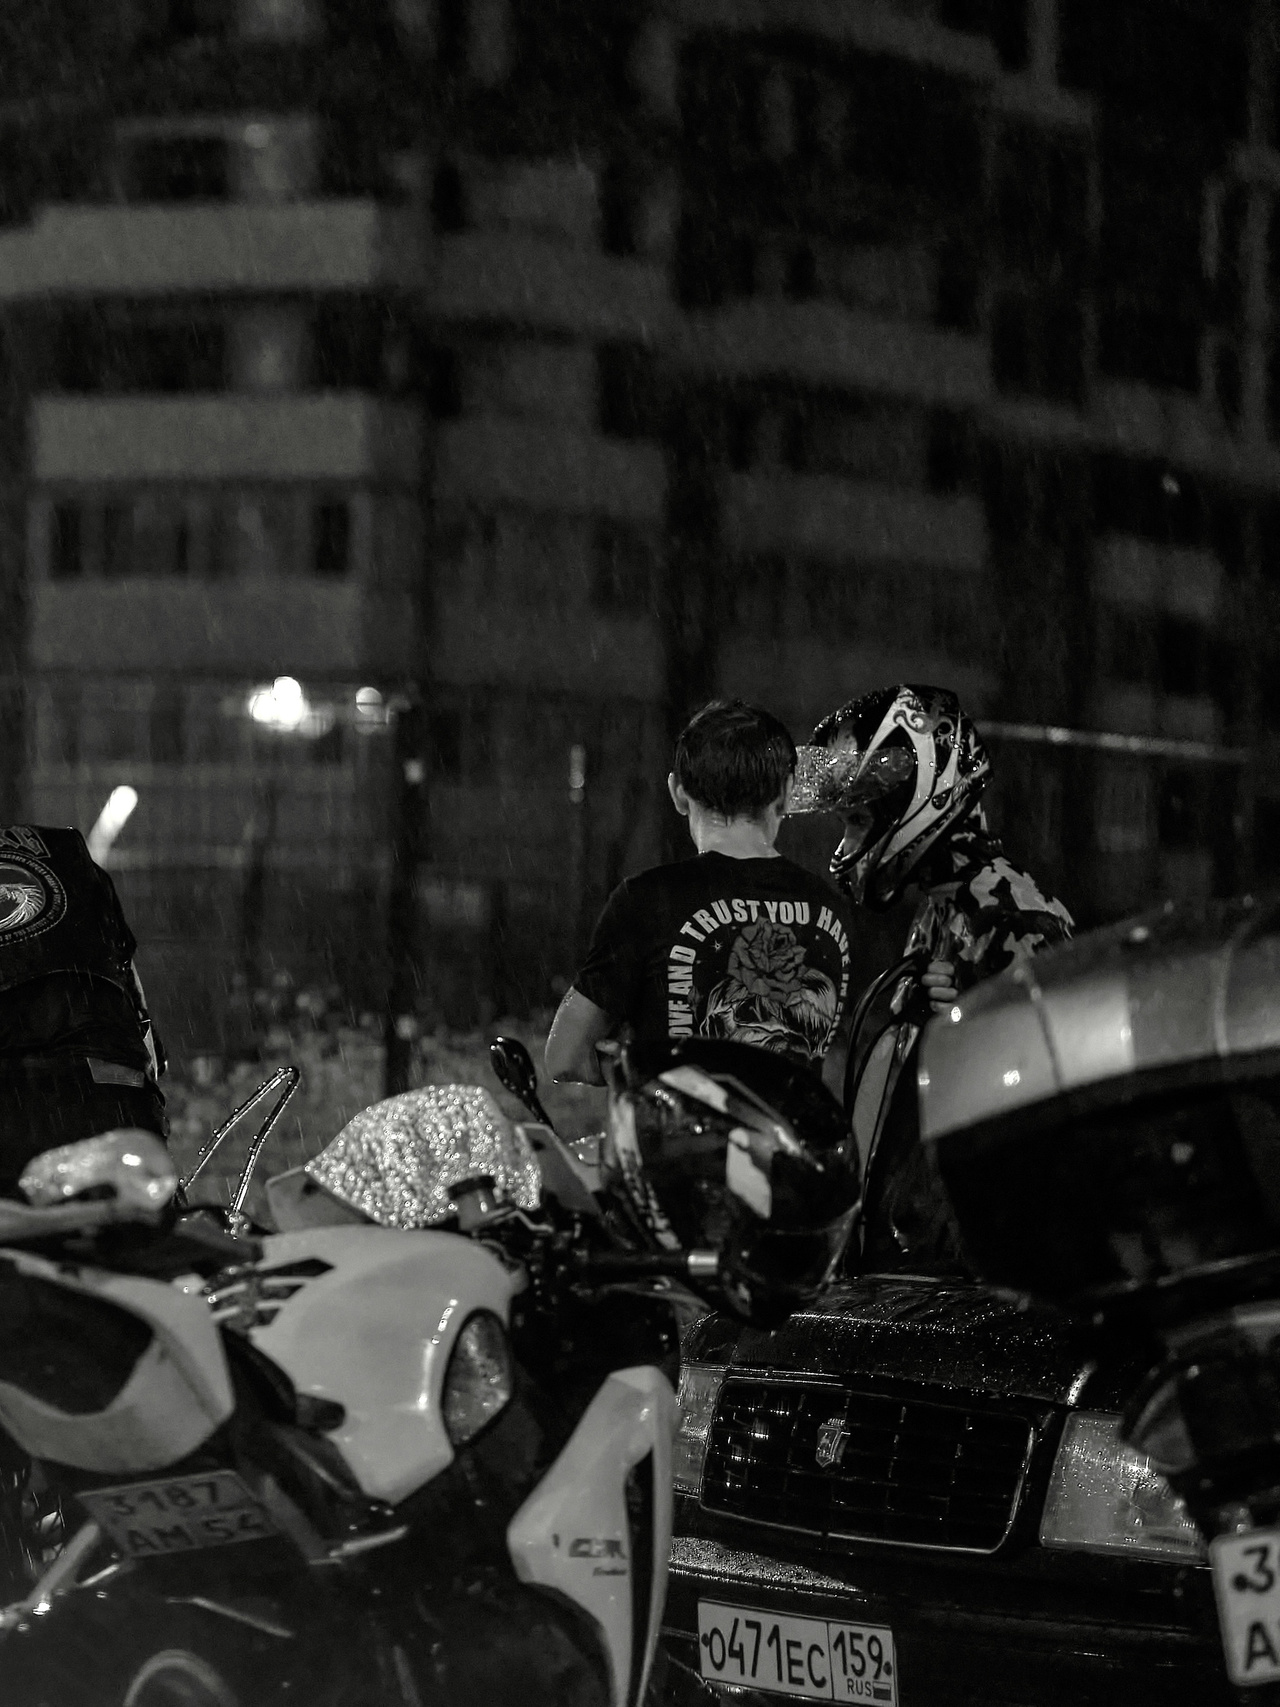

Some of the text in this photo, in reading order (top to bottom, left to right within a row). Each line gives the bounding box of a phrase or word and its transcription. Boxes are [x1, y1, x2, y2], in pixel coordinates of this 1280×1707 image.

[679, 898, 761, 943] TRUST
[763, 900, 810, 925] YOU
[815, 905, 852, 968] HAVE
[667, 943, 697, 997] AND
[667, 999, 694, 1040] OVE
[103, 1480, 219, 1516] 3187
[832, 1630, 883, 1680] 159
[847, 1678, 873, 1697] RUS
